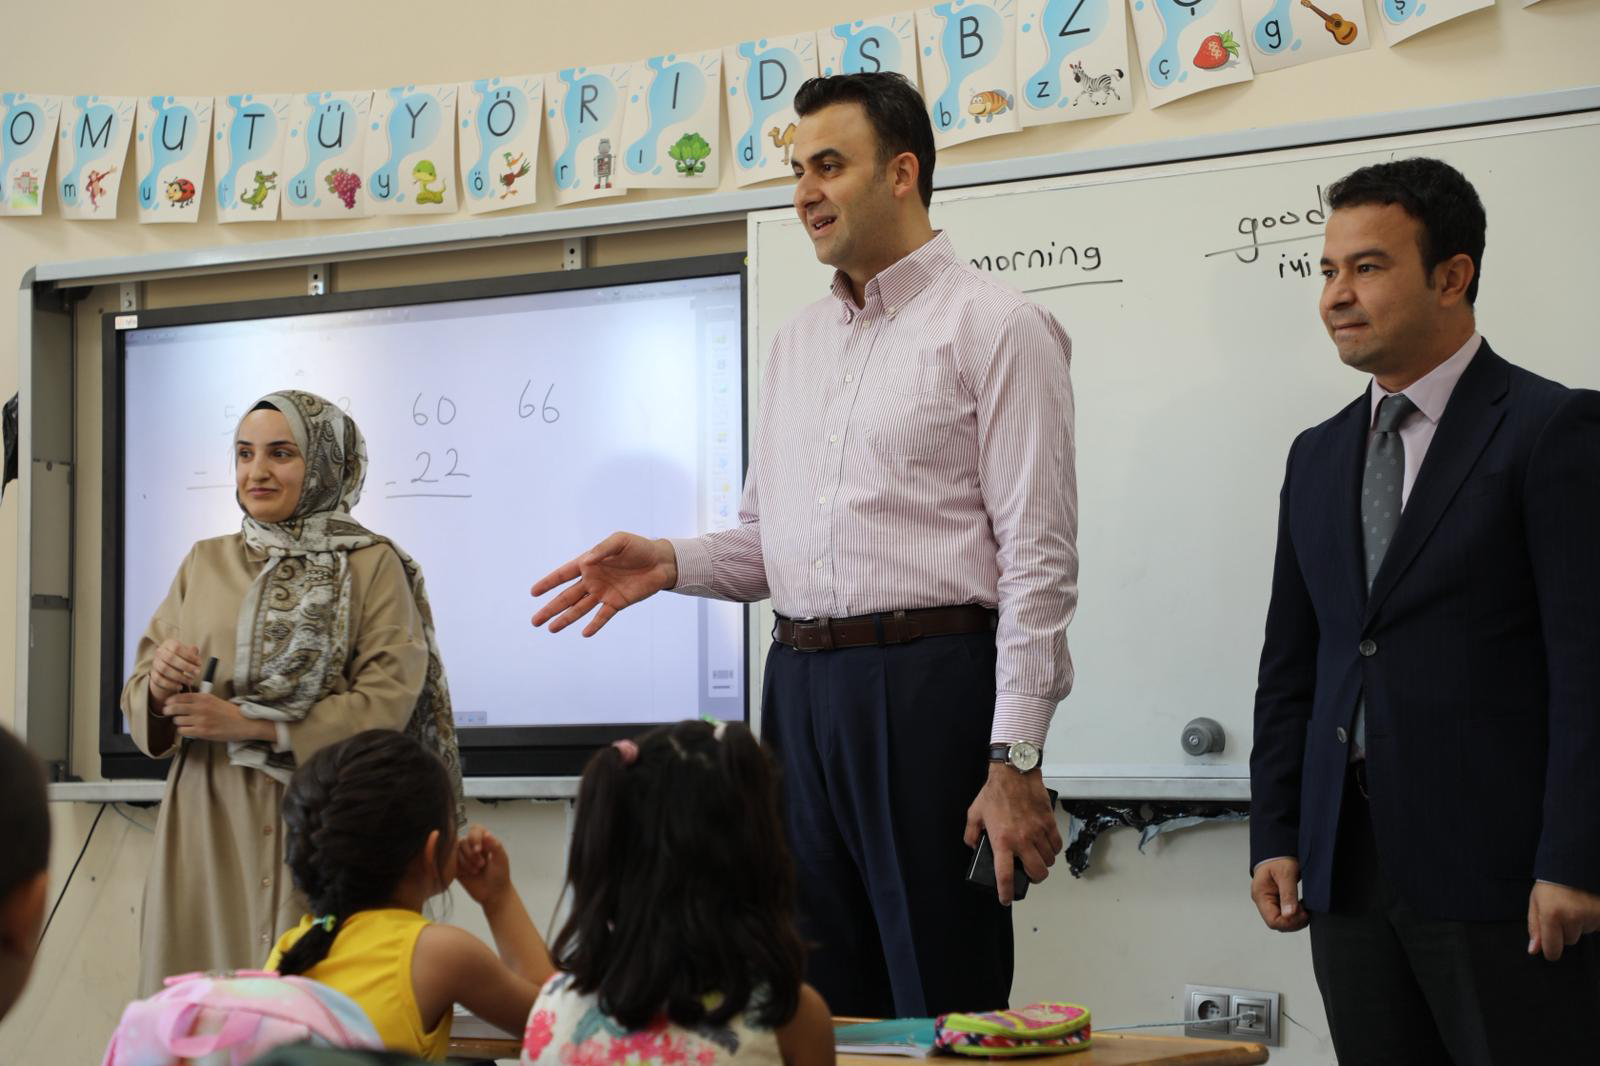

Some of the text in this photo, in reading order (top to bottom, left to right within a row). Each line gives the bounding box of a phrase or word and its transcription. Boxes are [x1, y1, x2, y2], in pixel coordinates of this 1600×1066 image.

[960, 16, 983, 59] B
[1265, 20, 1281, 49] g
[859, 37, 881, 73] S
[1159, 60, 1169, 79] ç
[760, 59, 787, 100] D
[1037, 82, 1049, 98] z
[406, 102, 427, 138] Y
[487, 91, 515, 136] Ö
[580, 85, 598, 123] R
[940, 102, 951, 127] b
[10, 111, 34, 145] O
[80, 114, 112, 147] M
[162, 115, 187, 150] U
[243, 114, 264, 149] T
[318, 105, 344, 148] Ü
[744, 136, 753, 161] d
[379, 175, 390, 198] y
[474, 172, 483, 191] ö
[561, 165, 567, 179] r
[64, 184, 75, 196] m
[144, 188, 150, 200] u
[296, 181, 307, 199] ü
[1235, 185, 1325, 264] good
[413, 393, 456, 426] 60
[519, 380, 559, 423] 66
